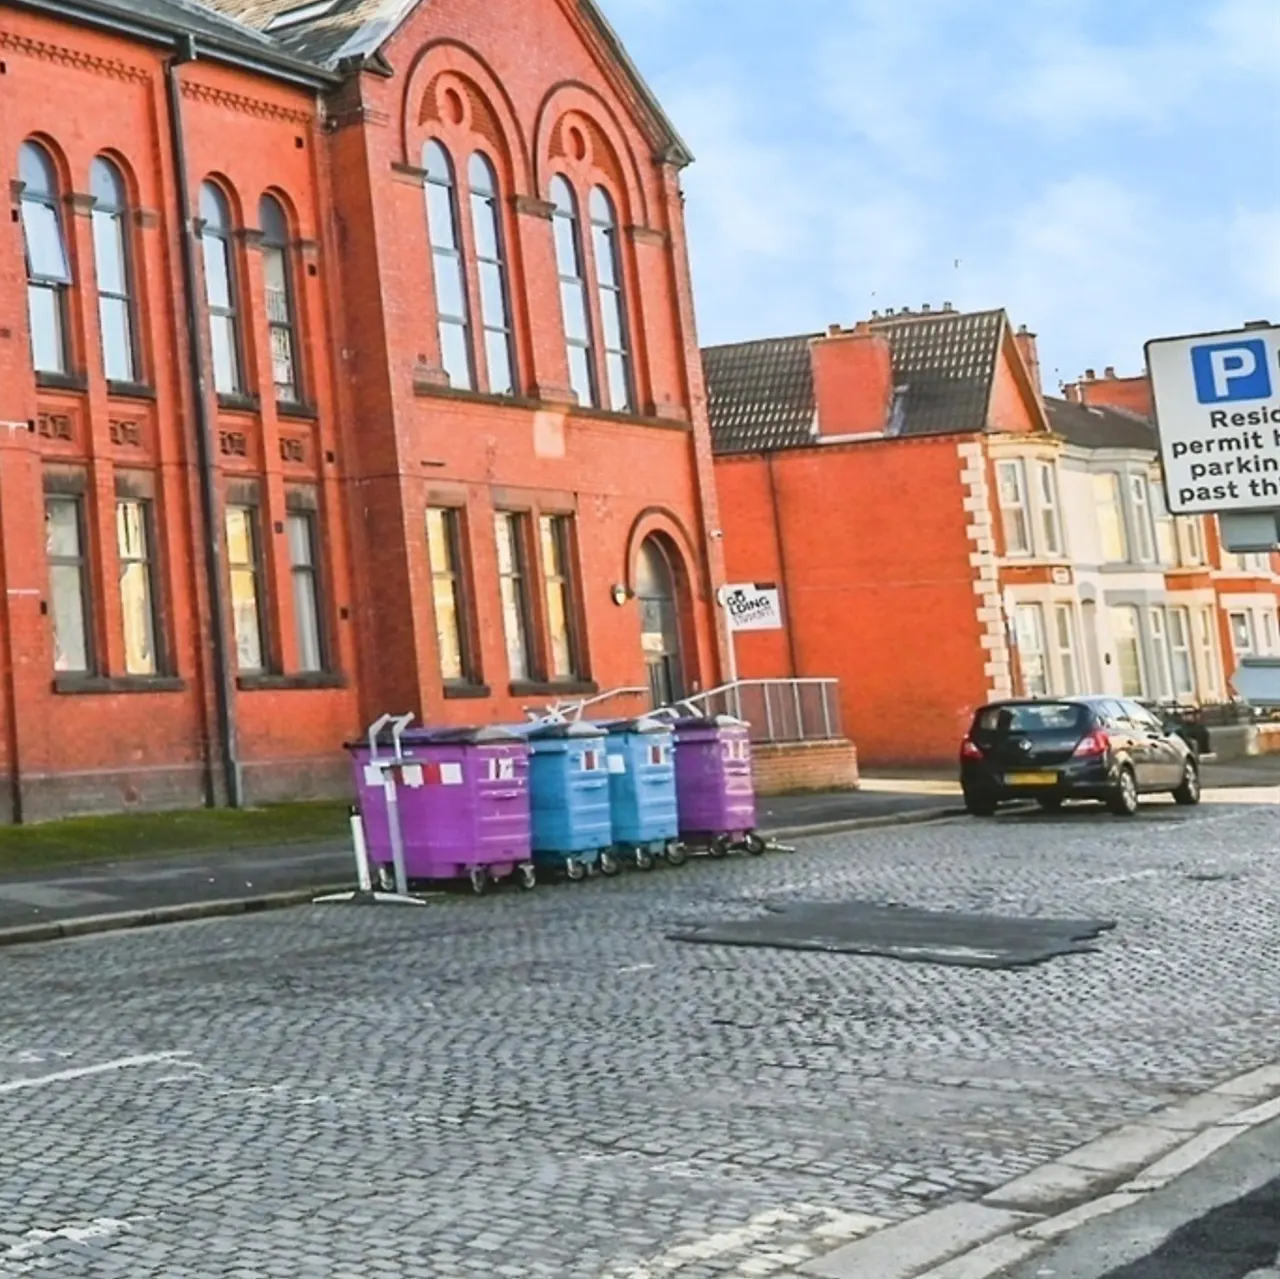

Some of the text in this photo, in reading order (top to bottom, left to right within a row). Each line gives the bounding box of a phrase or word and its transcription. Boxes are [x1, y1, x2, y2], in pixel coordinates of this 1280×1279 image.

[1210, 348, 1256, 397] P
[1172, 430, 1264, 458] permit
[1179, 476, 1280, 505] past th
